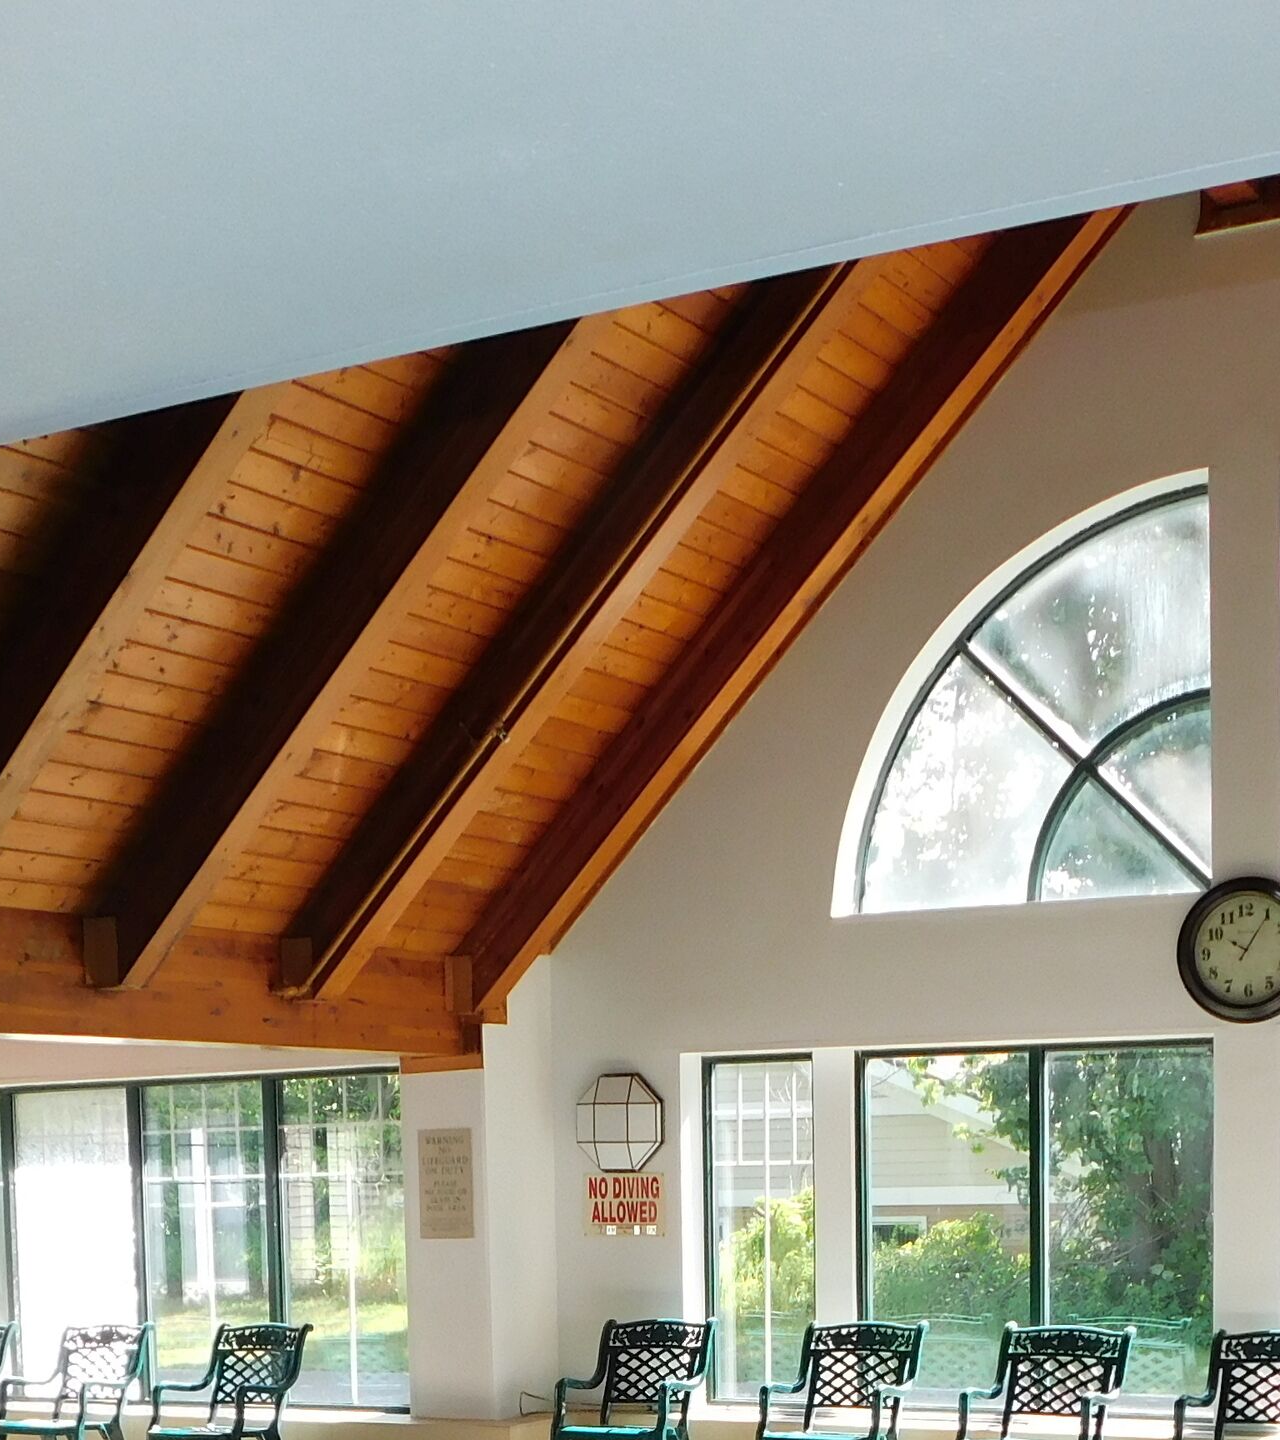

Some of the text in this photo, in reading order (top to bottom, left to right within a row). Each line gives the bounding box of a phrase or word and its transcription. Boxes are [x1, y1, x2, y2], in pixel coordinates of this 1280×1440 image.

[1238, 903, 1254, 917] 12
[1221, 911, 1235, 925] 11
[1208, 926, 1223, 941] 10
[1202, 948, 1211, 961] 9
[1209, 967, 1218, 979] 8
[1224, 979, 1233, 993] 7
[1244, 983, 1253, 997] 6
[1265, 976, 1274, 990] 5
[425, 1136, 464, 1145] WARNING
[422, 1156, 468, 1165] LIFEGUARD
[589, 1176, 660, 1199] NO DIVING
[592, 1200, 658, 1223] ALLOWED
